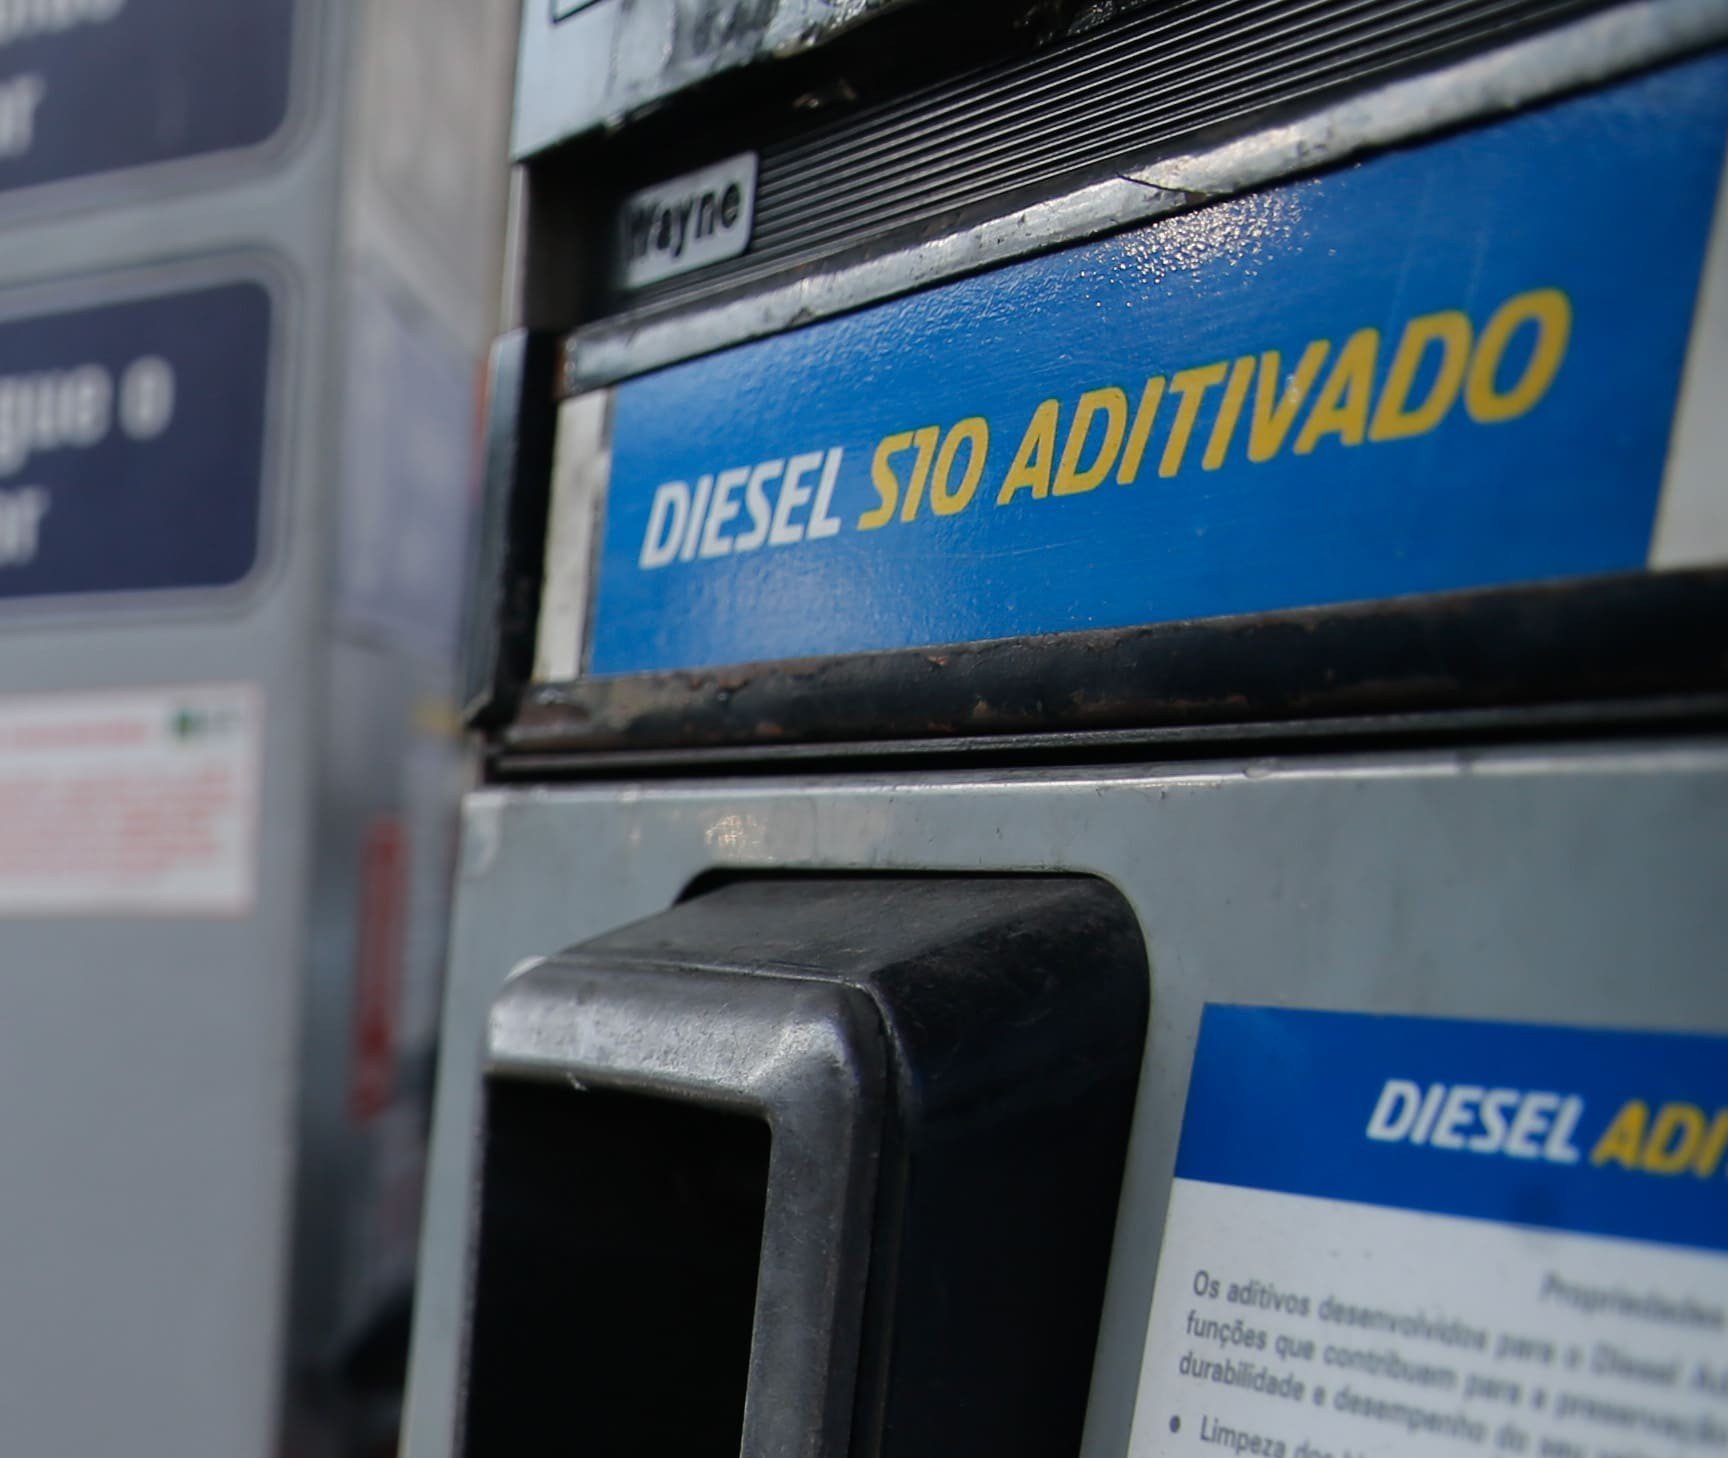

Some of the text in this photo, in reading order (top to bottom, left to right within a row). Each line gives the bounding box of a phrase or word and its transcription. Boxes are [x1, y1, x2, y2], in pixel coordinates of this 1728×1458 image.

[122, 357, 174, 440] o
[638, 289, 1572, 568] DIESEL S10 ADITIVADO
[1366, 1078, 1584, 1164] DIESEL
[1193, 1269, 1220, 1299] Os
[1227, 1279, 1310, 1317] aditivos
[1186, 1310, 1267, 1349] funções
[1275, 1334, 1315, 1362] que
[1323, 1344, 1458, 1391] contribuem
[1179, 1351, 1305, 1402] durabilidade
[1313, 1385, 1326, 1406] e
[1333, 1386, 1488, 1444] desempenho
